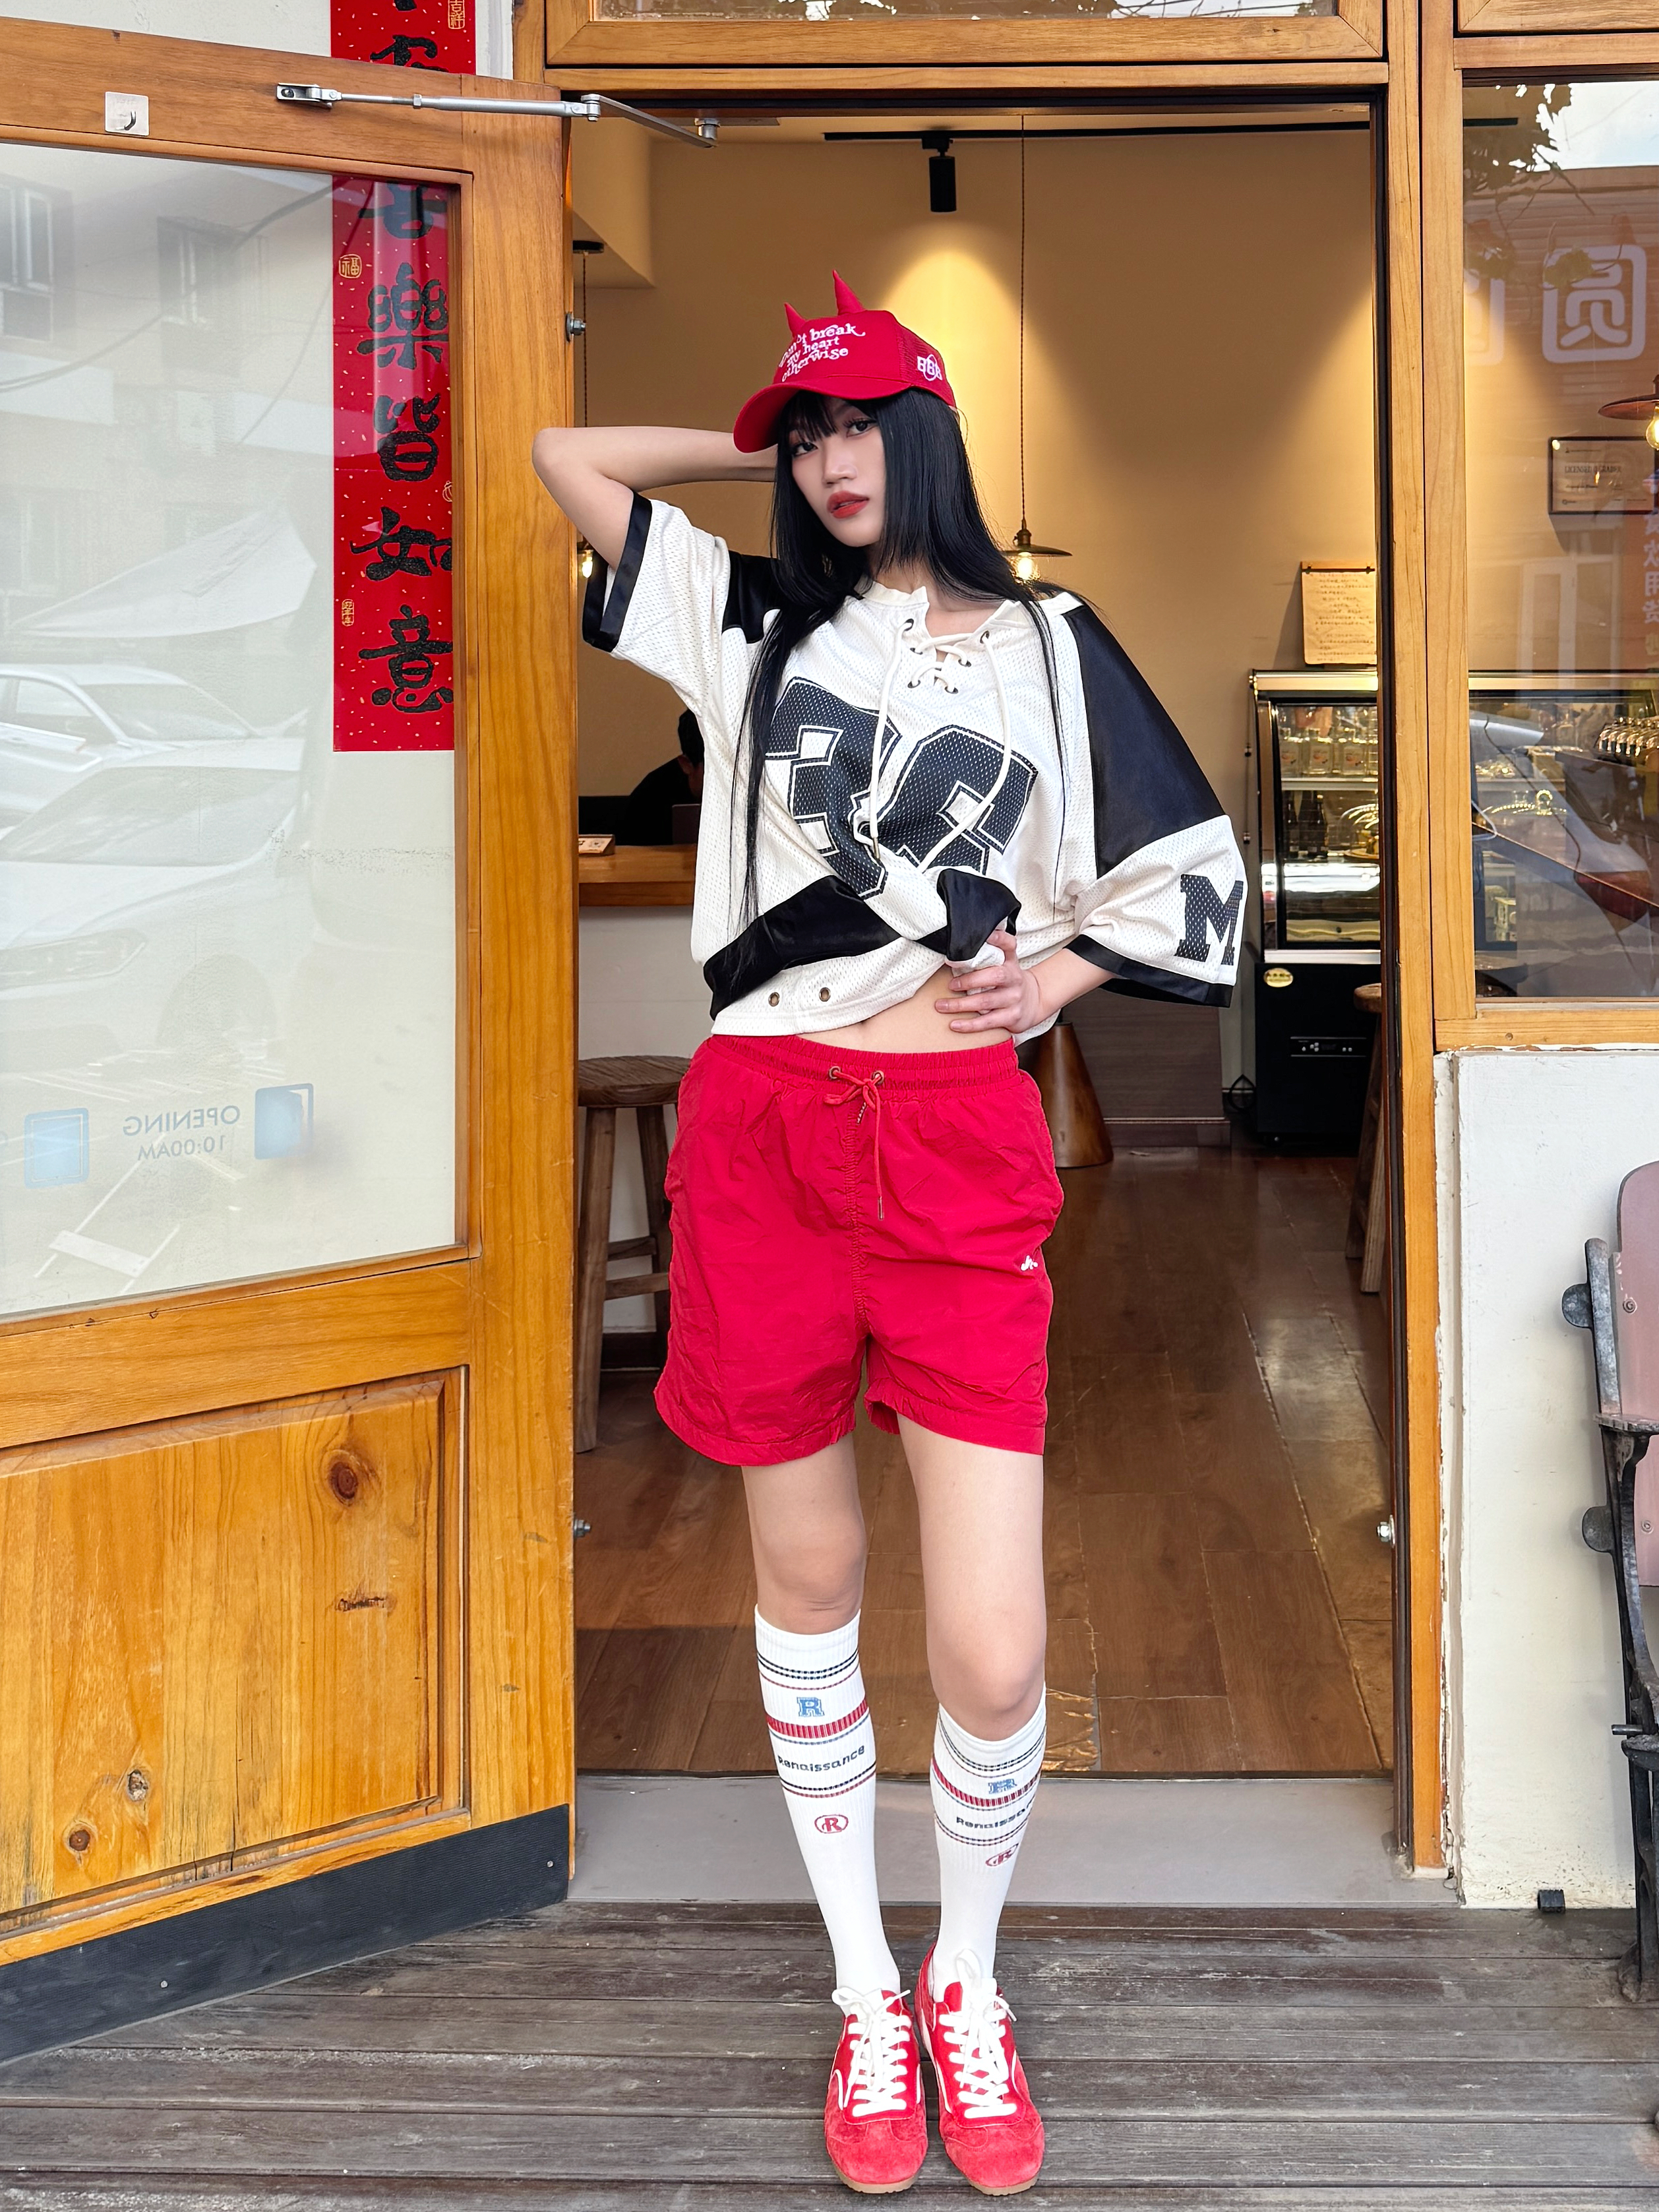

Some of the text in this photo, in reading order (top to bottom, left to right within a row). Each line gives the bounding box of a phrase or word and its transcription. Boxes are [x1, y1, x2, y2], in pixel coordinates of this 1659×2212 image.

[810, 323, 866, 342] break
[781, 347, 849, 382] otherwise
[787, 336, 839, 367] my heart
[1174, 875, 1244, 966] M
[797, 1697, 826, 1717] R
[777, 1744, 866, 1772] Renaissance
